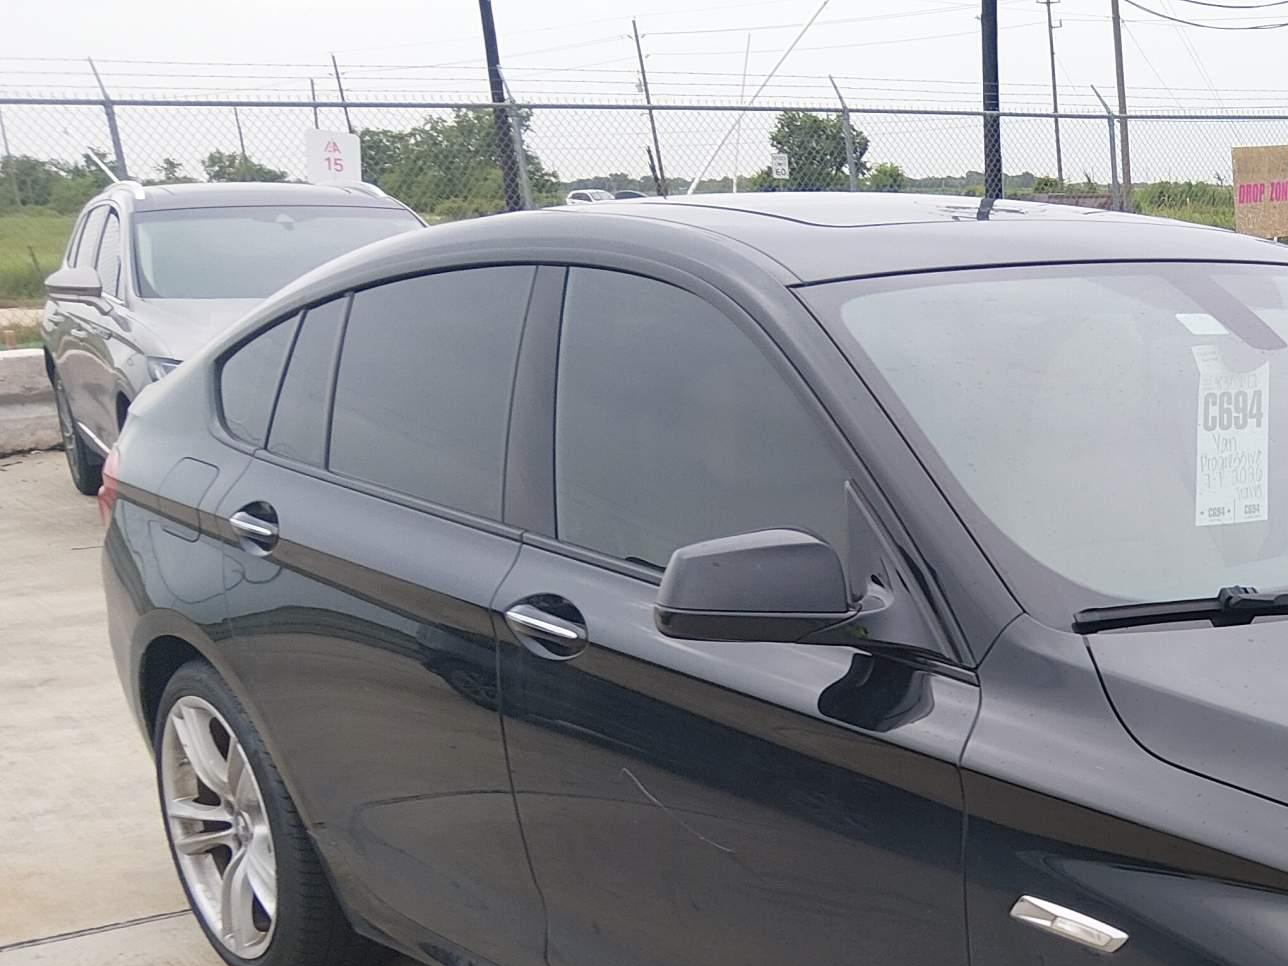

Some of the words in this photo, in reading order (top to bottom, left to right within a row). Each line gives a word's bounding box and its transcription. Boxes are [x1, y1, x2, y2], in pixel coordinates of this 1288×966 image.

[324, 157, 344, 172] 15
[1238, 183, 1265, 204] DROP
[1203, 390, 1263, 432] C694
[1208, 506, 1225, 518] C694
